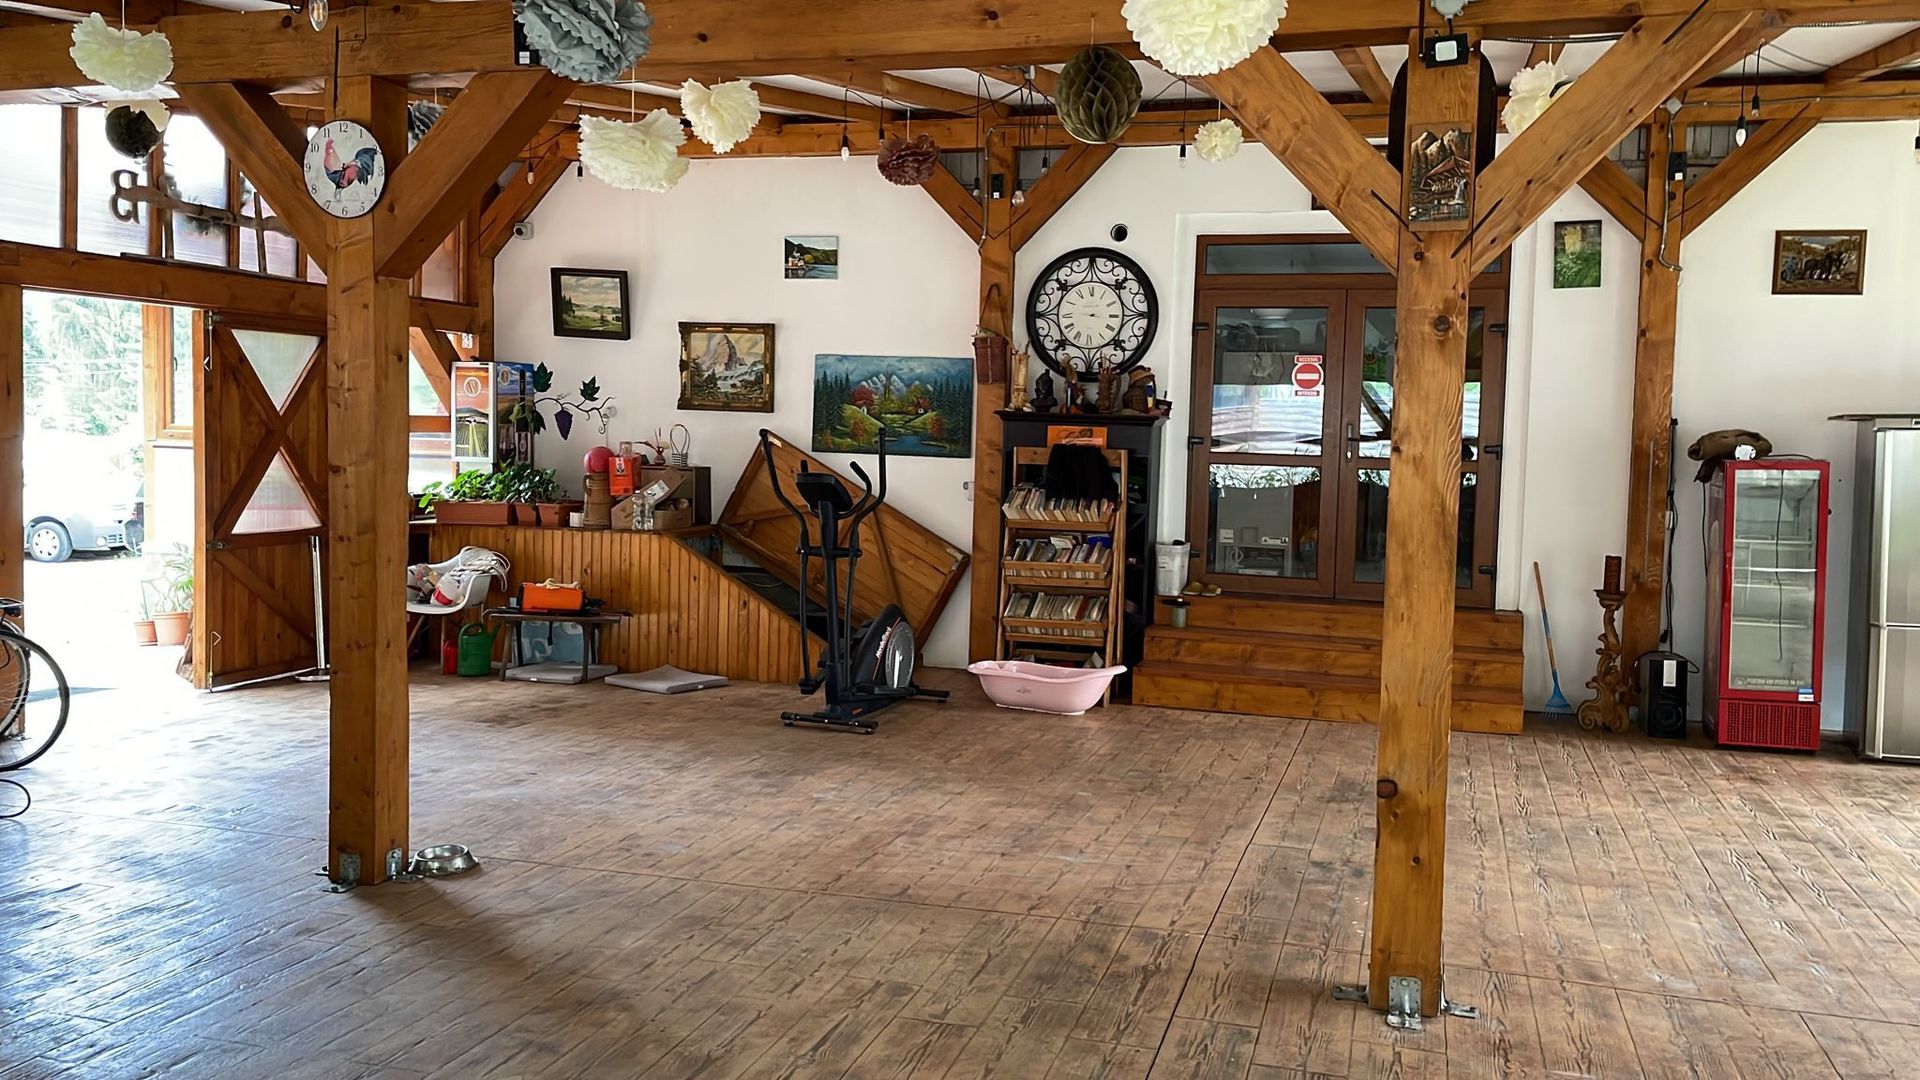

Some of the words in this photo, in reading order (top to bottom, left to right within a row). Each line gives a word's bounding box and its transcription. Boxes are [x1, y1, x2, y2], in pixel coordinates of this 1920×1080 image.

[323, 128, 330, 138] 11
[339, 122, 349, 133] 12
[359, 128, 363, 139] 1
[310, 143, 320, 153] 10
[305, 163, 311, 173] 9
[378, 166, 384, 177] 3
[311, 184, 317, 195] 8
[324, 200, 331, 210] 7
[360, 201, 365, 212] 5
[341, 206, 348, 217] 6
